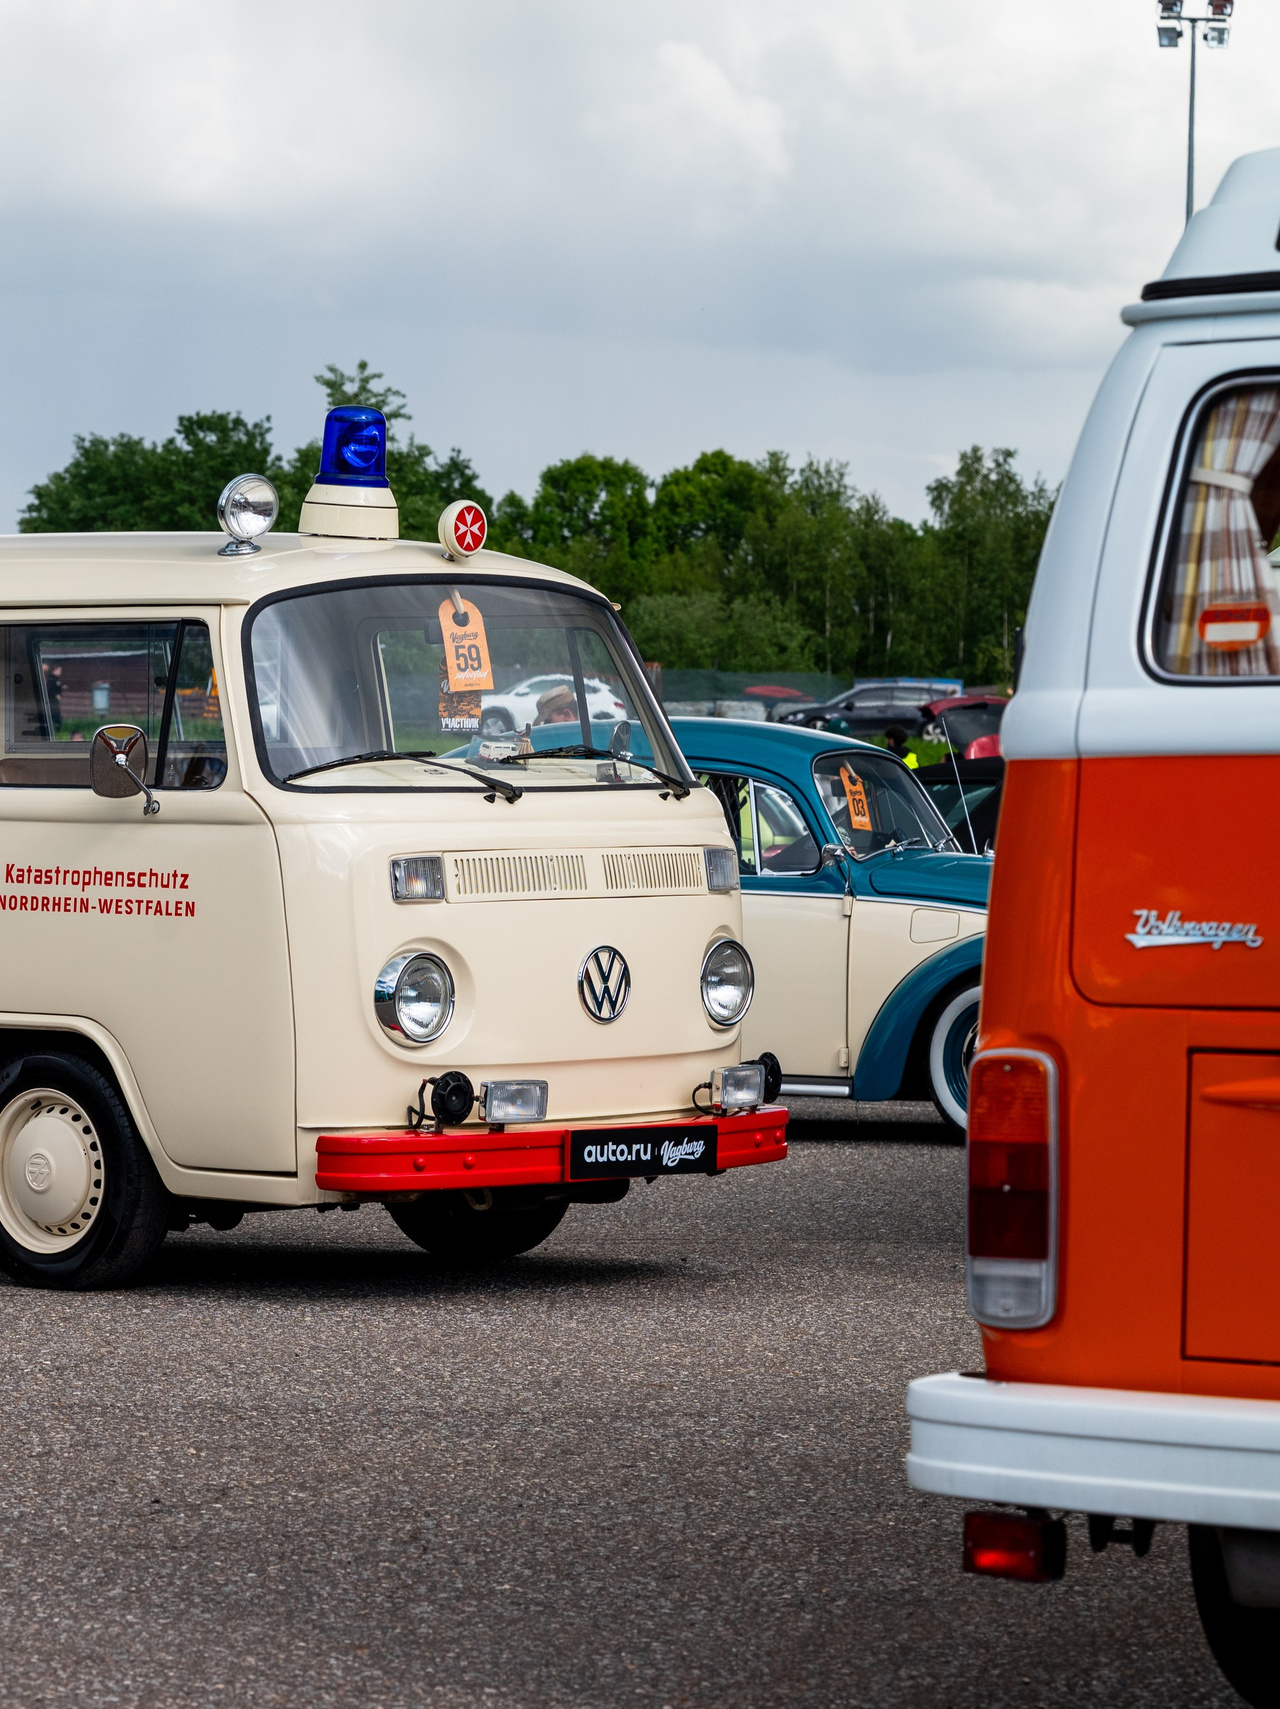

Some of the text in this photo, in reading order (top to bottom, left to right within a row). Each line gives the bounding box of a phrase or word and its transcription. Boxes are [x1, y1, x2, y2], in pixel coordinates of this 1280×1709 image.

[455, 644, 482, 673] 59
[454, 669, 489, 680] selected
[441, 717, 479, 729] УЧАСТНИК
[852, 798, 866, 817] 03
[5, 863, 190, 892] Katastrophenschutz
[579, 947, 628, 1021] VW
[584, 1137, 705, 1167] auto.ru Vagburg
